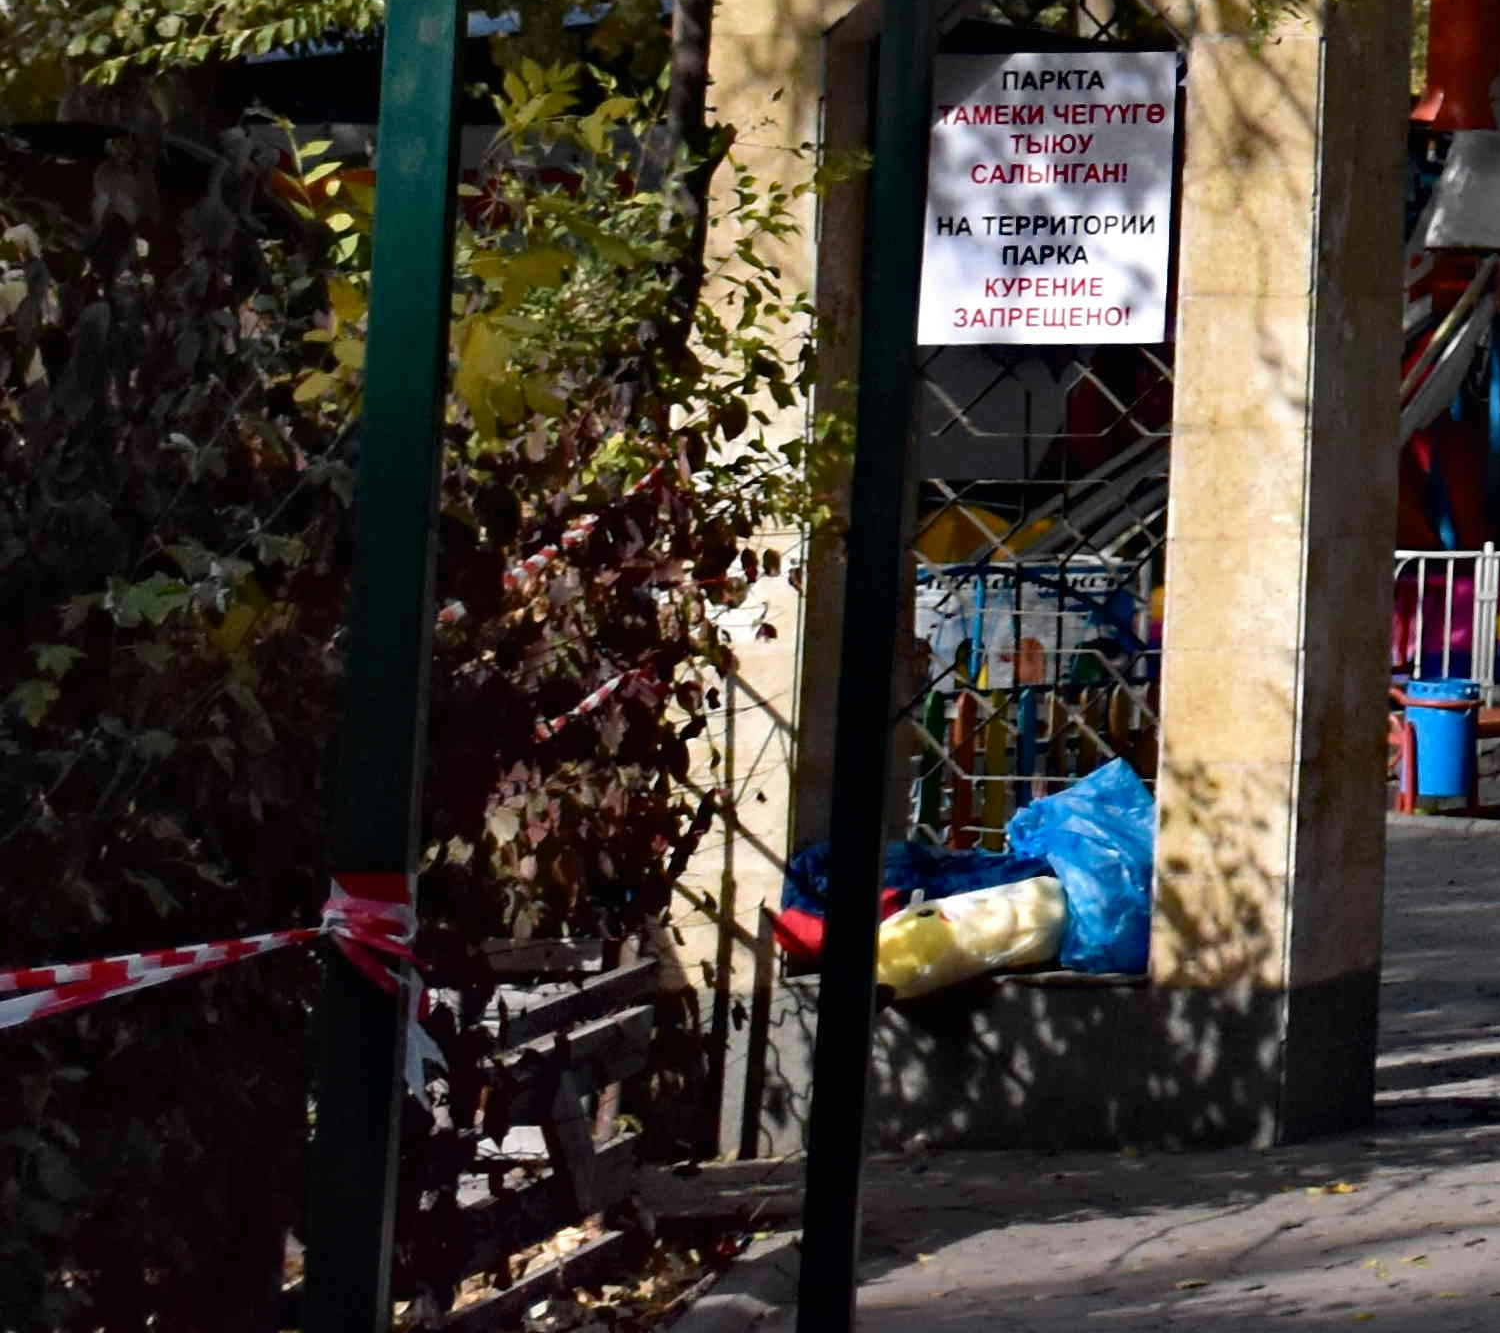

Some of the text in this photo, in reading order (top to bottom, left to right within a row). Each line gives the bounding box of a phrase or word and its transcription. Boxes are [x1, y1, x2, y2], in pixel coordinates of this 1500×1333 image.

[1001, 70, 1105, 91] ПАРКТА
[939, 103, 1165, 125] ТАМЕКИ ЧЕГҮҮГӨ
[1010, 134, 1093, 154] ТЫЮУ
[971, 163, 1128, 184] САЛЫНГАН!
[936, 215, 1156, 237] НА ТЕРРИТОРИИ
[1002, 245, 1088, 266] ПАРКА
[985, 278, 1103, 297] КУРЕНИЕ
[953, 307, 1131, 330] ЗАПРЕЩЕНО!
